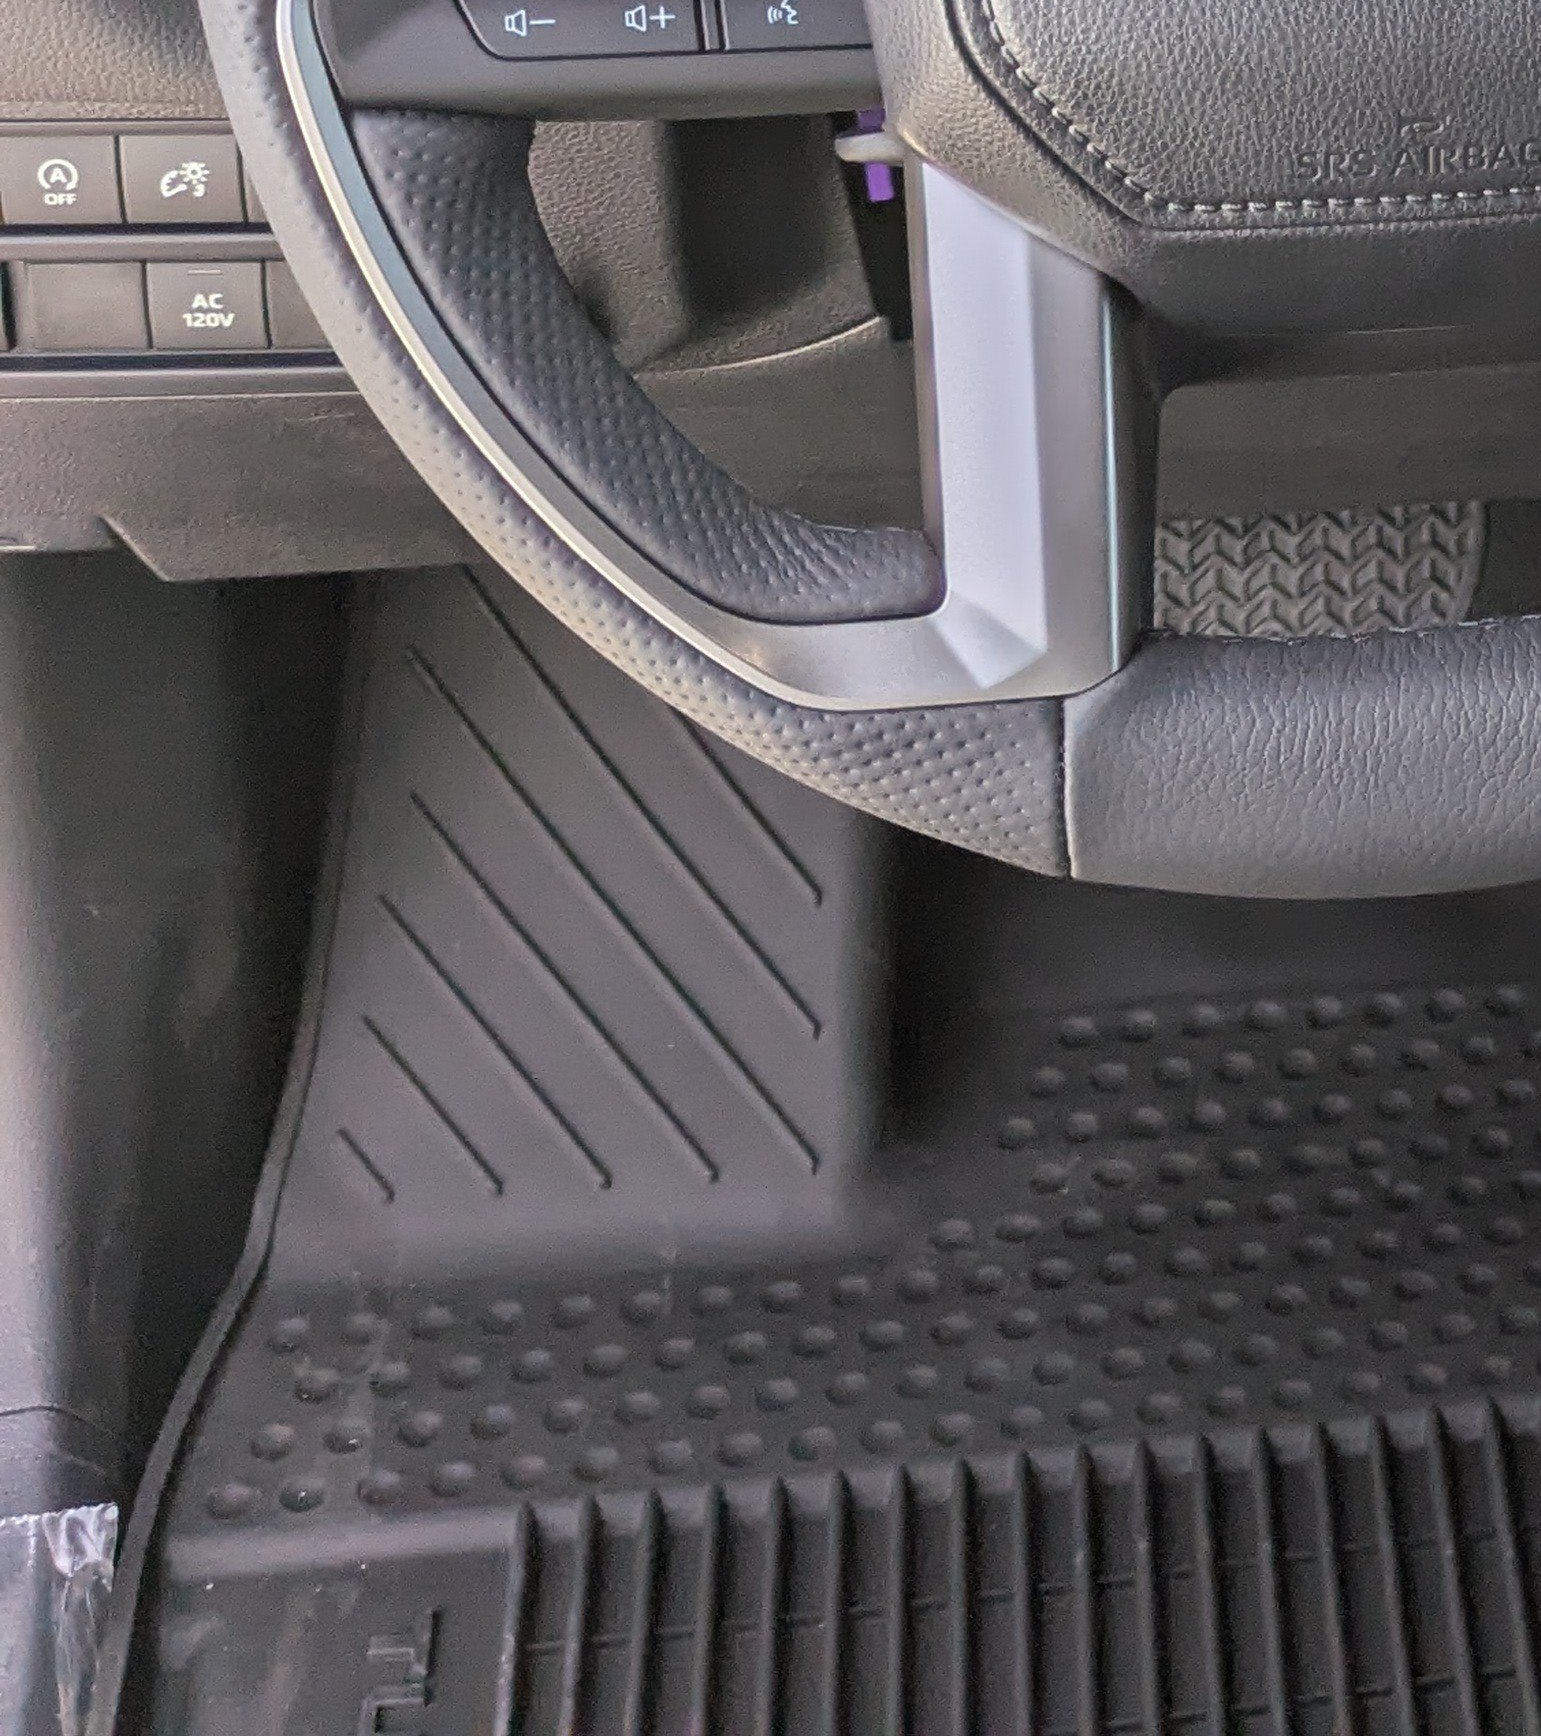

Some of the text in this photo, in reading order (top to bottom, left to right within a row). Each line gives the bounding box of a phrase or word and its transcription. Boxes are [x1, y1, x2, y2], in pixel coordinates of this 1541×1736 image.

[44, 193, 77, 205] OFF
[191, 294, 224, 309] AC
[182, 313, 235, 328] 120V
